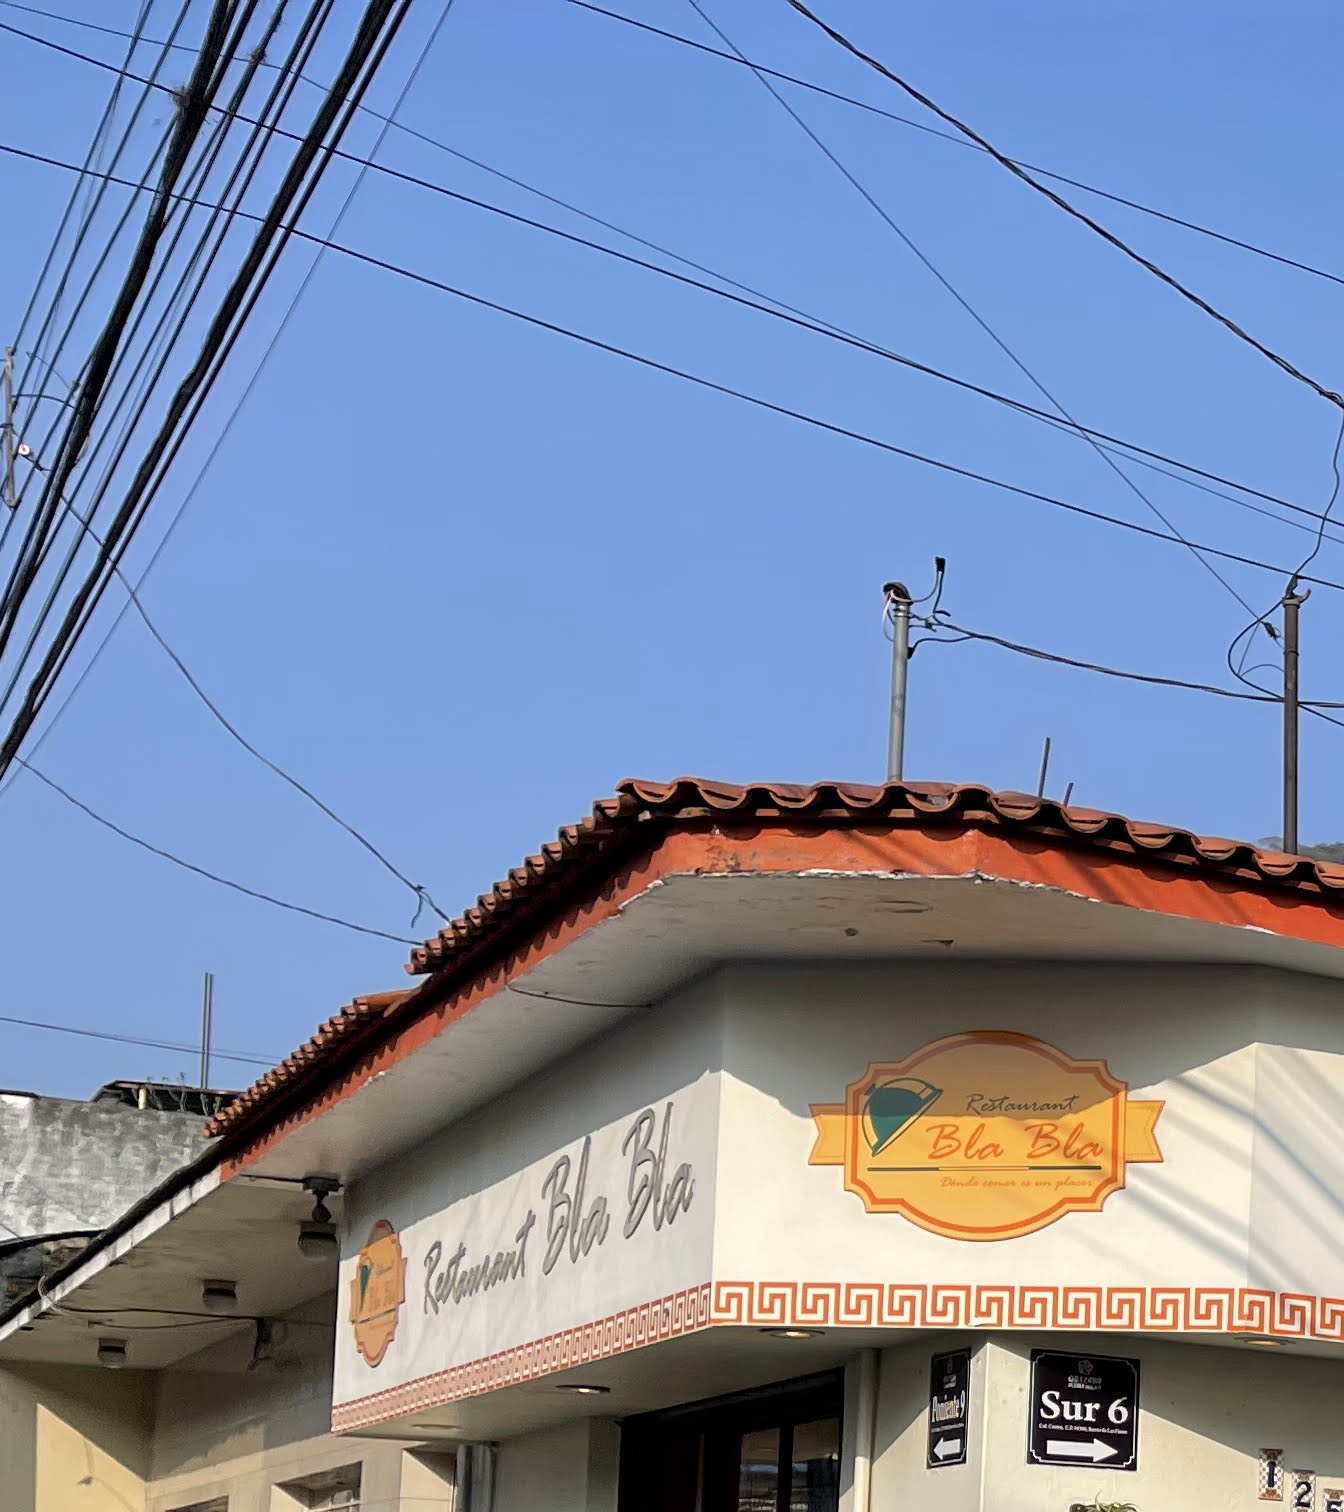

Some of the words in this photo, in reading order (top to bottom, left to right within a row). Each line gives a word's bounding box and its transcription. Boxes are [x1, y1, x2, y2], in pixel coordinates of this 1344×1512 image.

[966, 1094, 1079, 1115] Restaurant
[926, 1122, 1004, 1160] Bla
[1024, 1122, 1103, 1160] Bla
[424, 1209, 536, 1315] Restaurant
[542, 1136, 611, 1276] Bla
[622, 1101, 695, 1239] Bla
[960, 1390, 966, 1418] 9
[1040, 1390, 1100, 1422] Sur
[1108, 1397, 1128, 1424] 6
